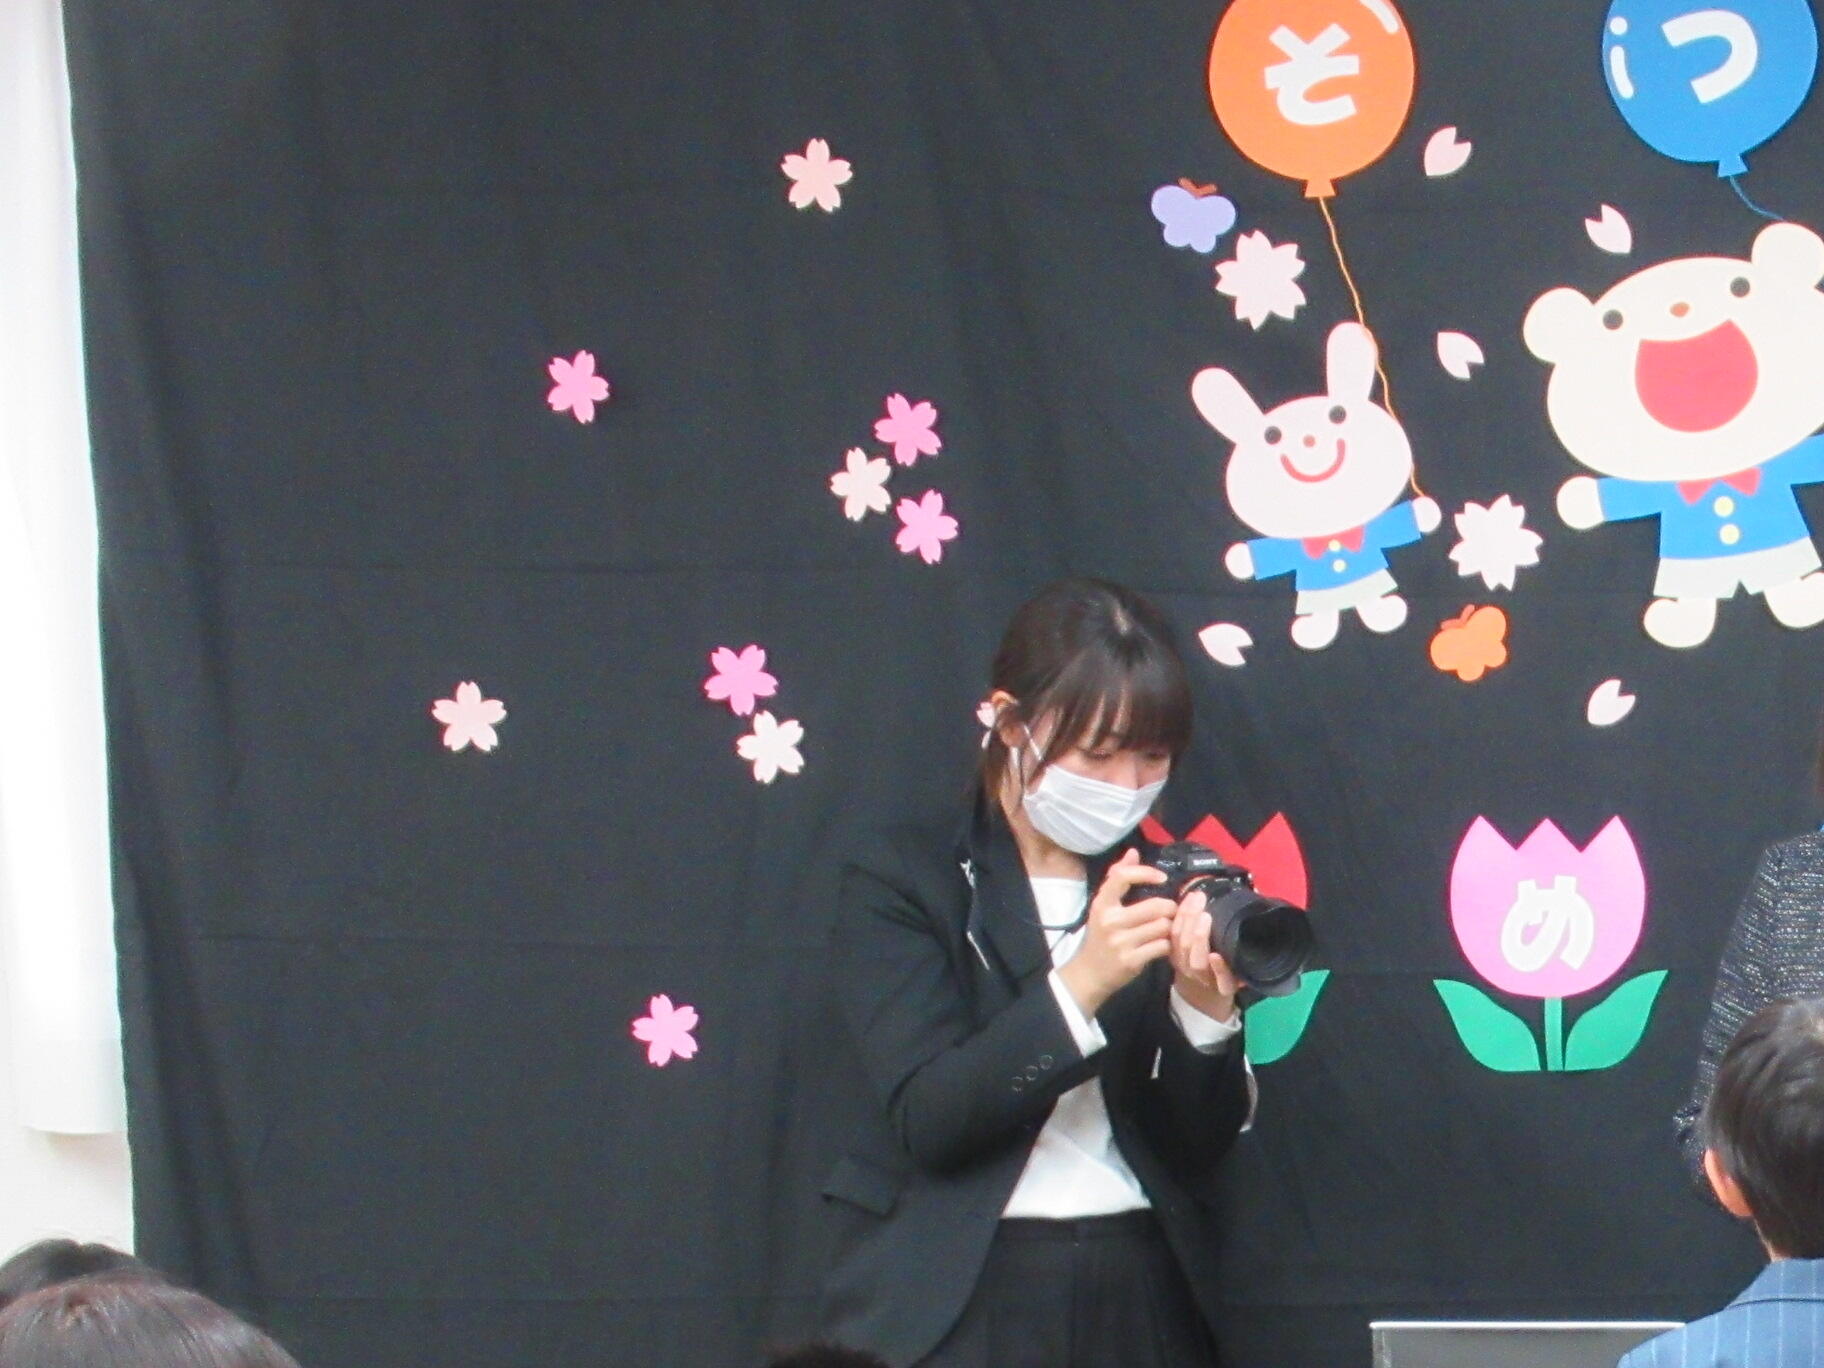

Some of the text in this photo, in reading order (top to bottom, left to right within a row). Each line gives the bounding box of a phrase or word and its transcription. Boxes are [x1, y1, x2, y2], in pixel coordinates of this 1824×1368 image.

[1264, 23, 1360, 126] そ
[1661, 9, 1758, 104] つ
[1501, 874, 1595, 973] め
